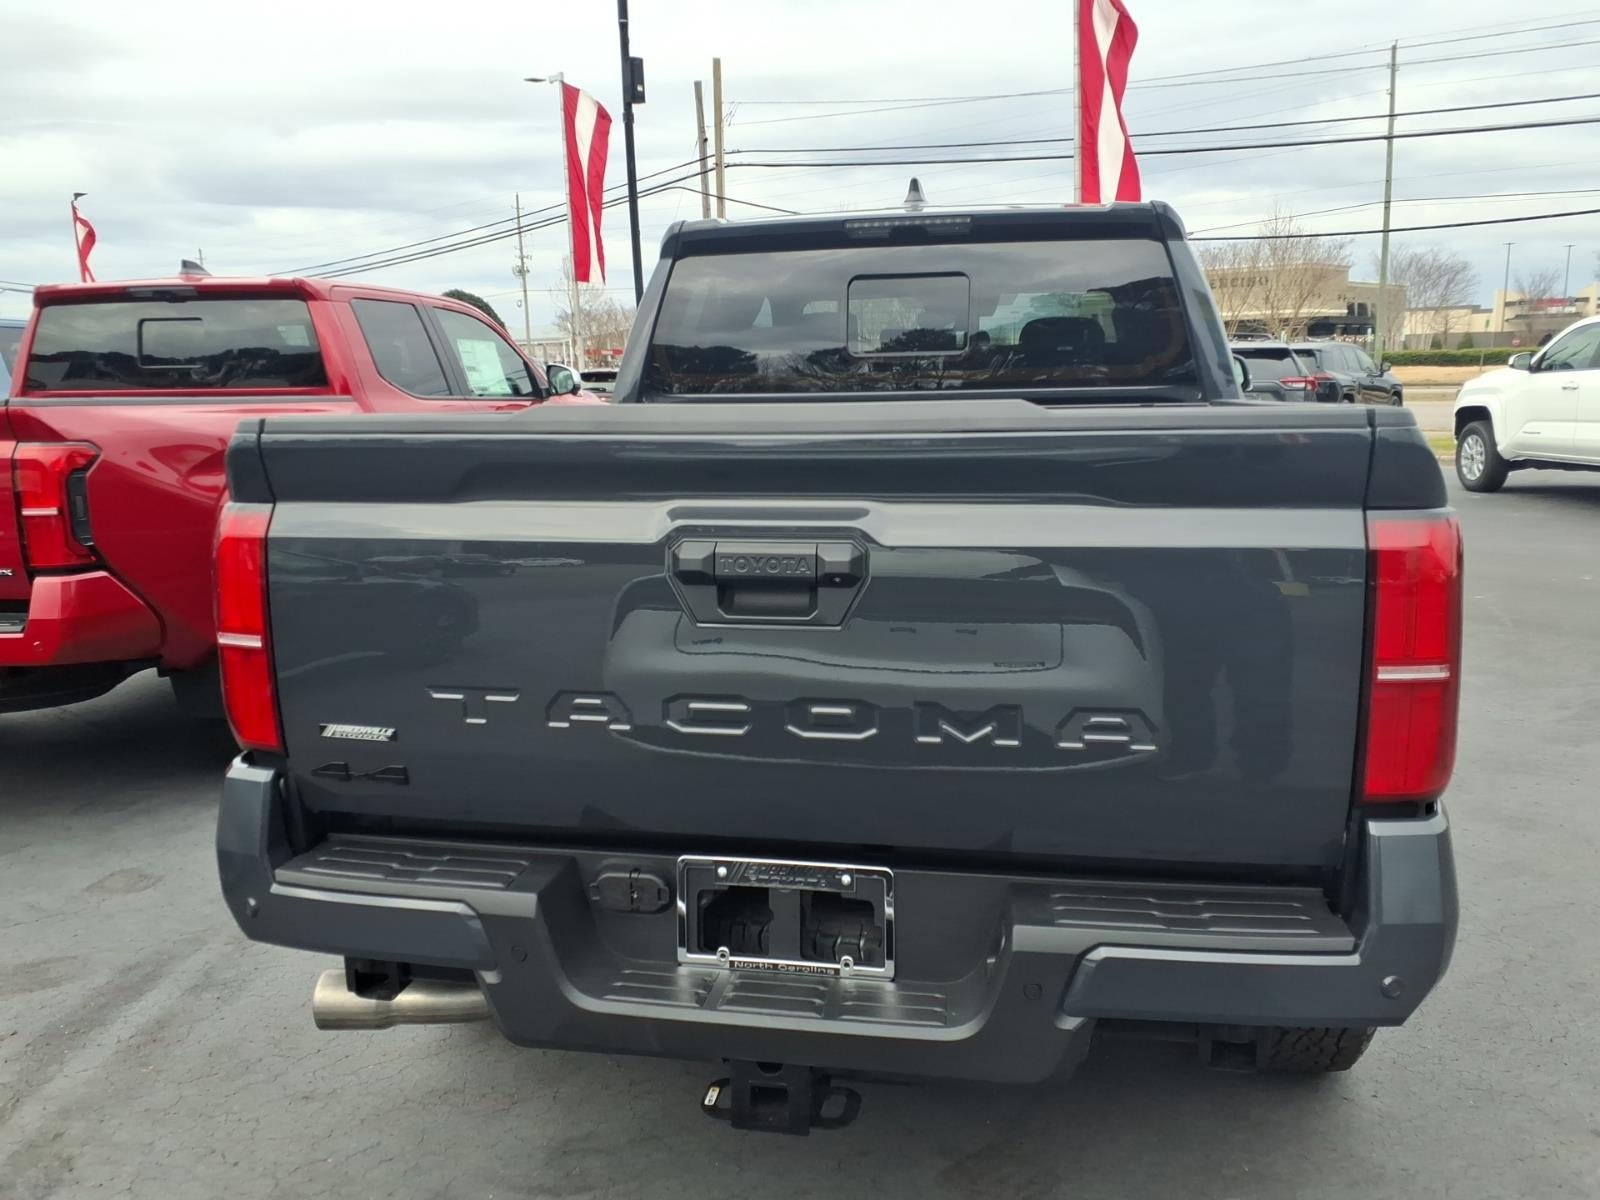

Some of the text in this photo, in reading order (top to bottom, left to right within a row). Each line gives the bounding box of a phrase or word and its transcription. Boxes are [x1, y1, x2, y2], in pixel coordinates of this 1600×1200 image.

[720, 556, 812, 574] TOYOTA
[426, 684, 1158, 753] TACOMA
[734, 960, 836, 975] North Carolina
